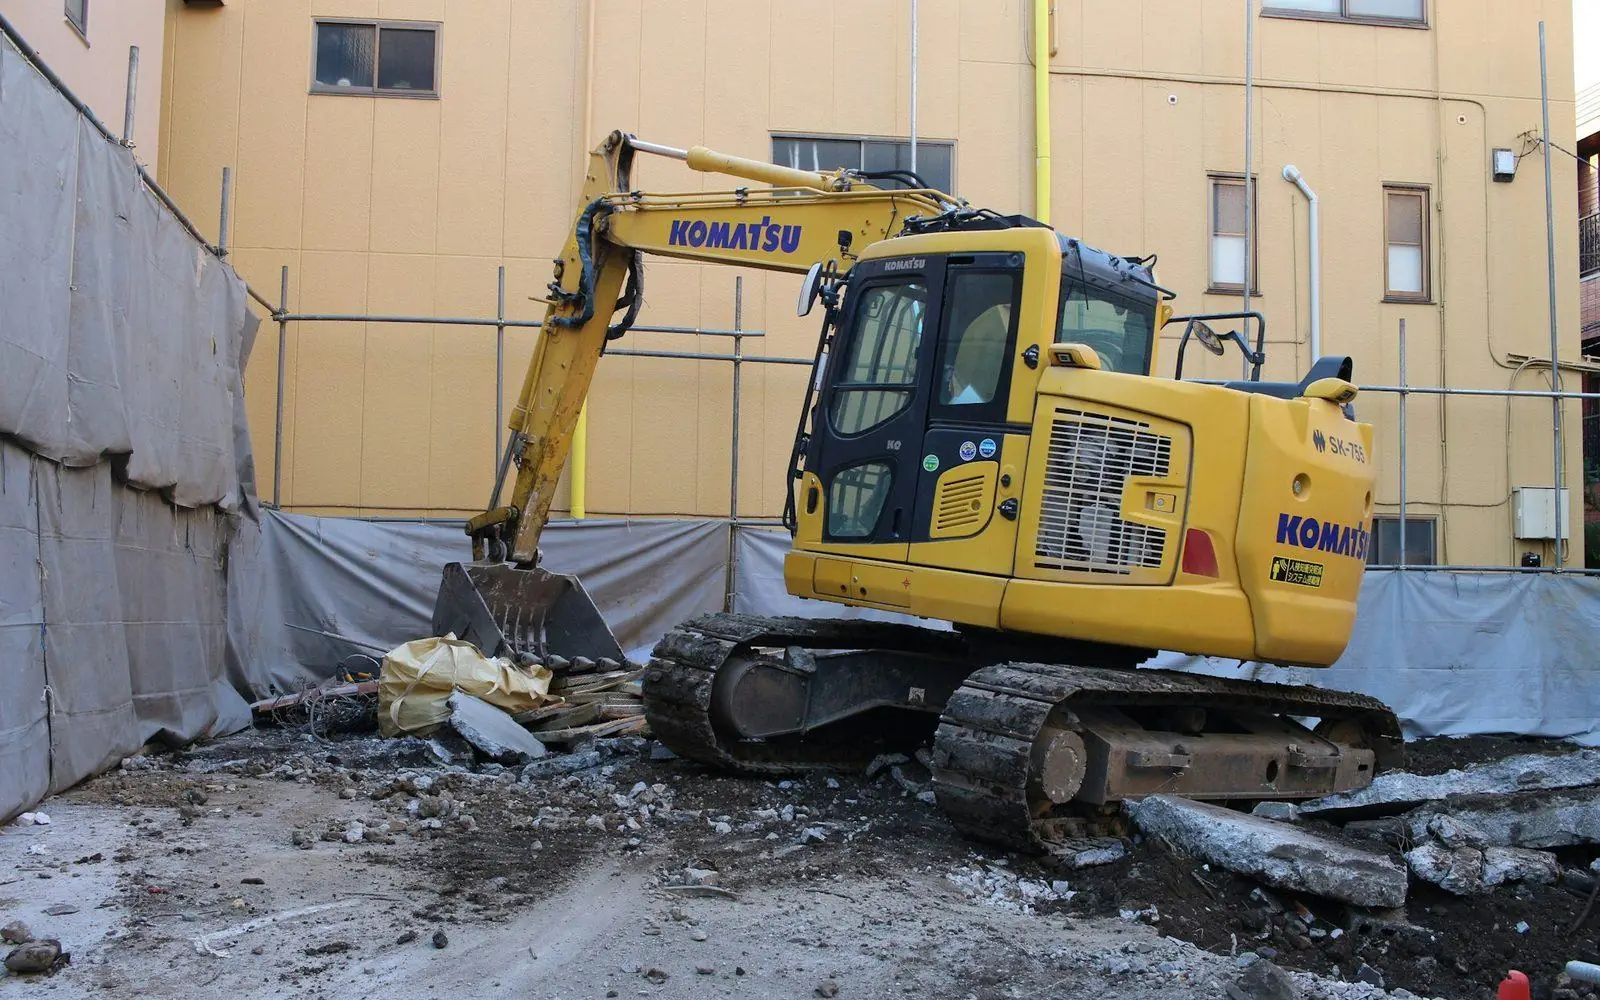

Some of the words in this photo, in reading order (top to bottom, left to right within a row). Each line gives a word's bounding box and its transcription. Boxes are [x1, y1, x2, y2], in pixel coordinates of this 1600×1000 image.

[668, 215, 802, 253] KOMATSU
[884, 257, 926, 271] KOMATSU
[1329, 435, 1365, 463] SK-755
